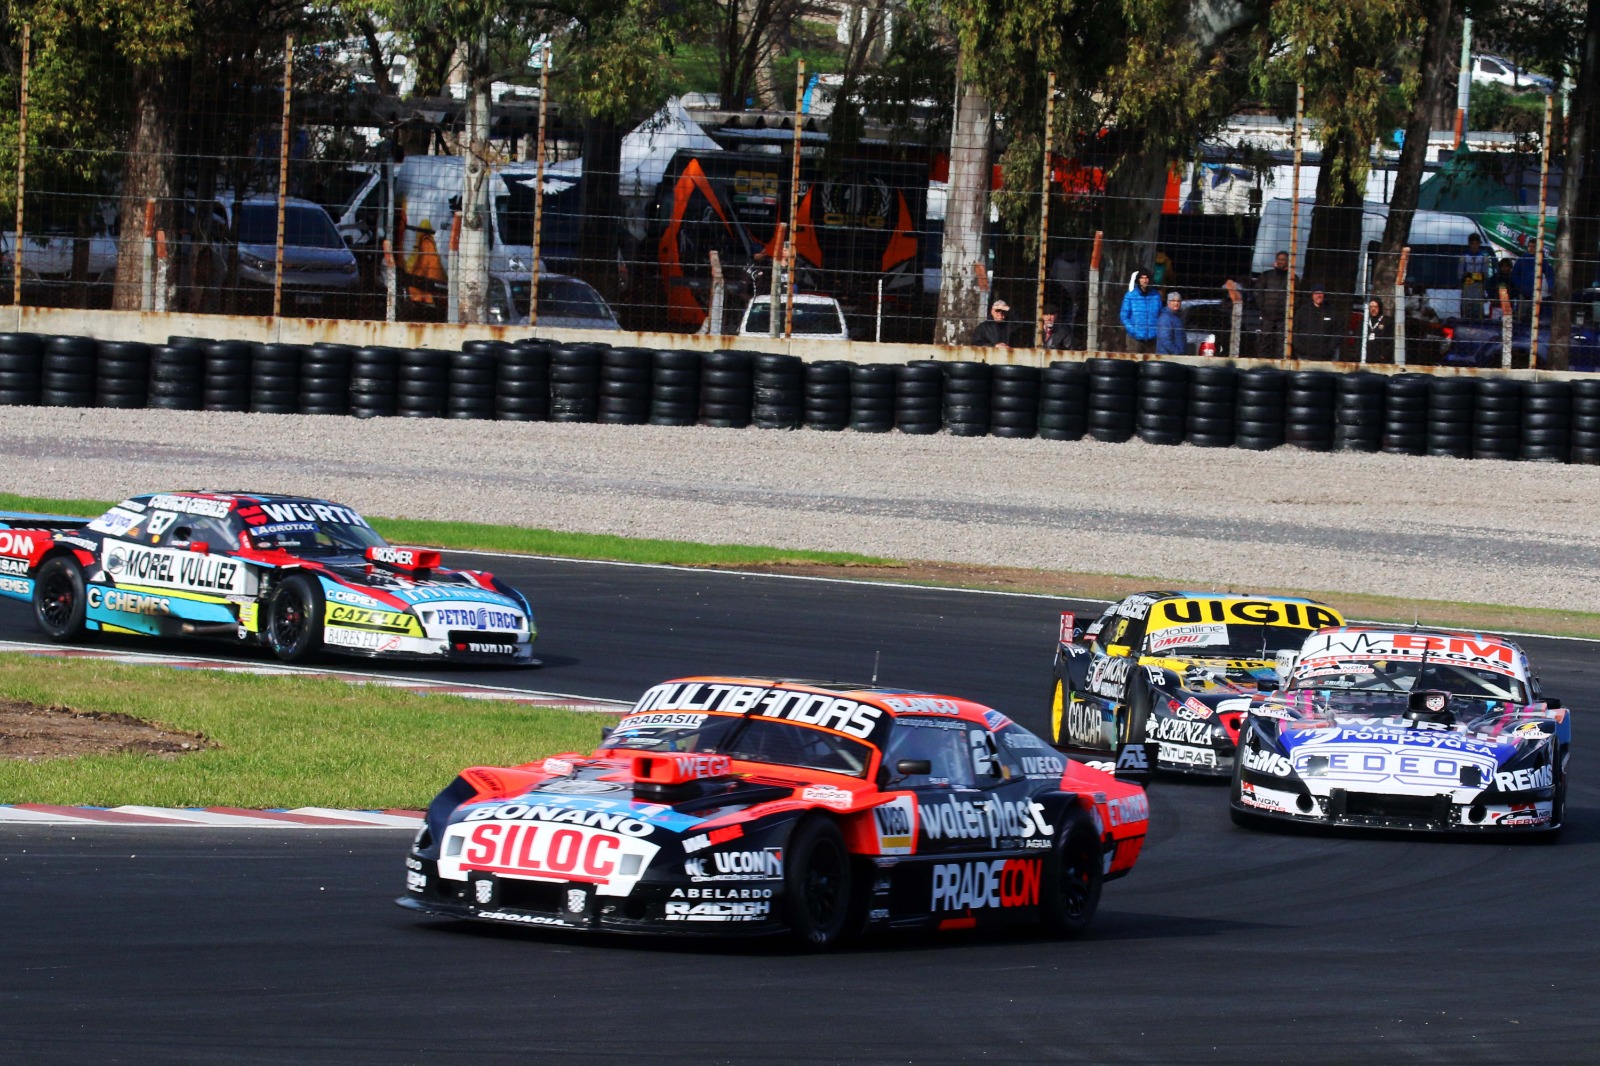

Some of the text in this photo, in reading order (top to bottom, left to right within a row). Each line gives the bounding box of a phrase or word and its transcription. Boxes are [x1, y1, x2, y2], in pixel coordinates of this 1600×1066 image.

[147, 511, 178, 534] 87
[258, 523, 314, 535] AGROTAX
[126, 549, 237, 590] MOREL VULLIEZ
[104, 591, 171, 616] CHEMES
[331, 606, 412, 628] CATELLI
[437, 608, 518, 630] PETRO URCO
[328, 628, 383, 649] BAIRES FLY
[1151, 624, 1224, 641] Mobiline
[1154, 635, 1200, 649] OMBU
[1393, 634, 1515, 663] BM
[631, 683, 883, 739] MULTIBANDAS
[883, 698, 959, 715] BLANCO
[1068, 702, 1102, 744] COLCAR
[1156, 718, 1213, 745] SCIENZA
[1342, 729, 1462, 748] Pompeya
[675, 756, 731, 778] WEGA
[1021, 756, 1065, 774] IVECO
[463, 804, 656, 837] BONANO
[918, 793, 1055, 849] waterplast
[466, 823, 621, 877] SILOC
[1025, 839, 1053, 849] AGUA
[669, 888, 773, 899] ABELARDO
[931, 859, 1043, 913] PRADECON
[477, 911, 574, 927] CROACIA
